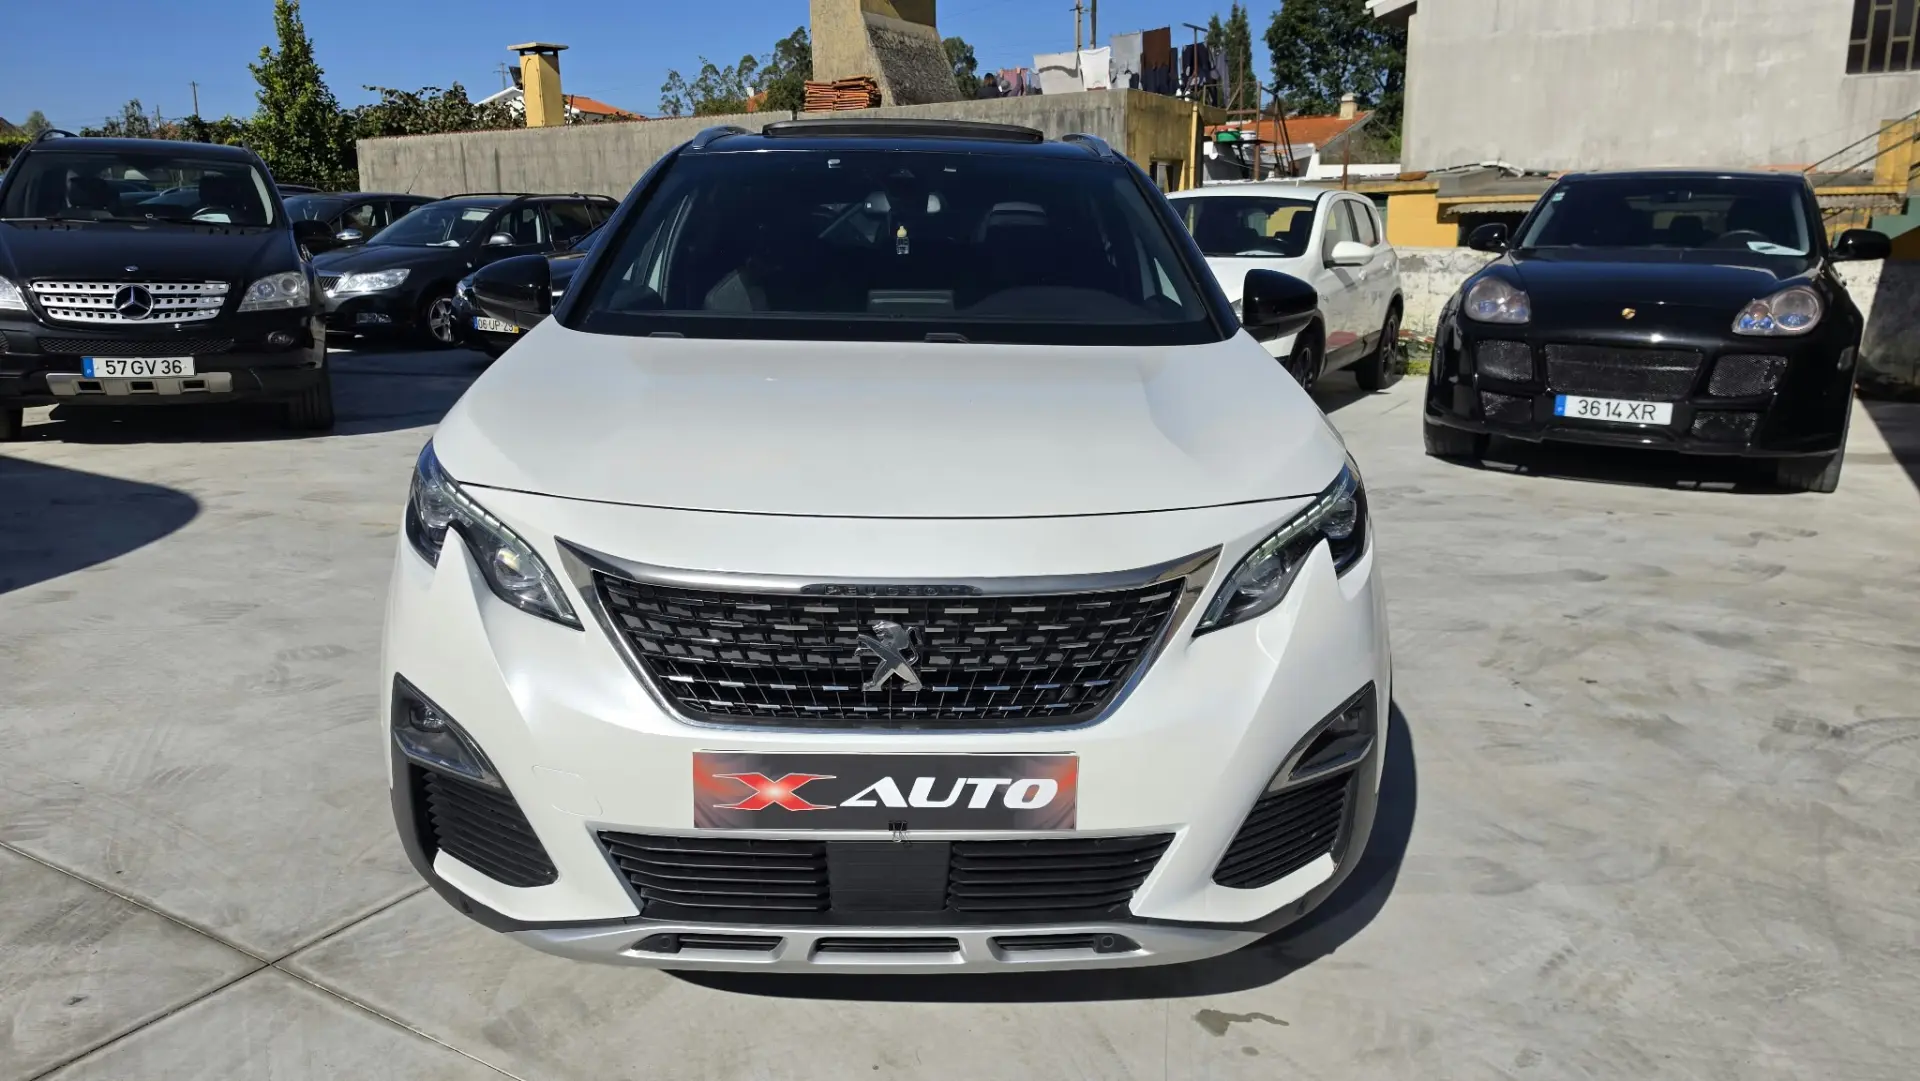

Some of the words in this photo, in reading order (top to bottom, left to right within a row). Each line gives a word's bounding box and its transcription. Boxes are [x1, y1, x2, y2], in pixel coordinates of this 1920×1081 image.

[105, 360, 127, 375] 57
[130, 360, 157, 375] GV
[161, 359, 183, 374] 36
[1578, 399, 1601, 416] 36
[1605, 401, 1622, 418] 14
[1626, 403, 1657, 421] XR
[825, 585, 962, 597] PEUGEOT
[839, 775, 1058, 810] AUTO
